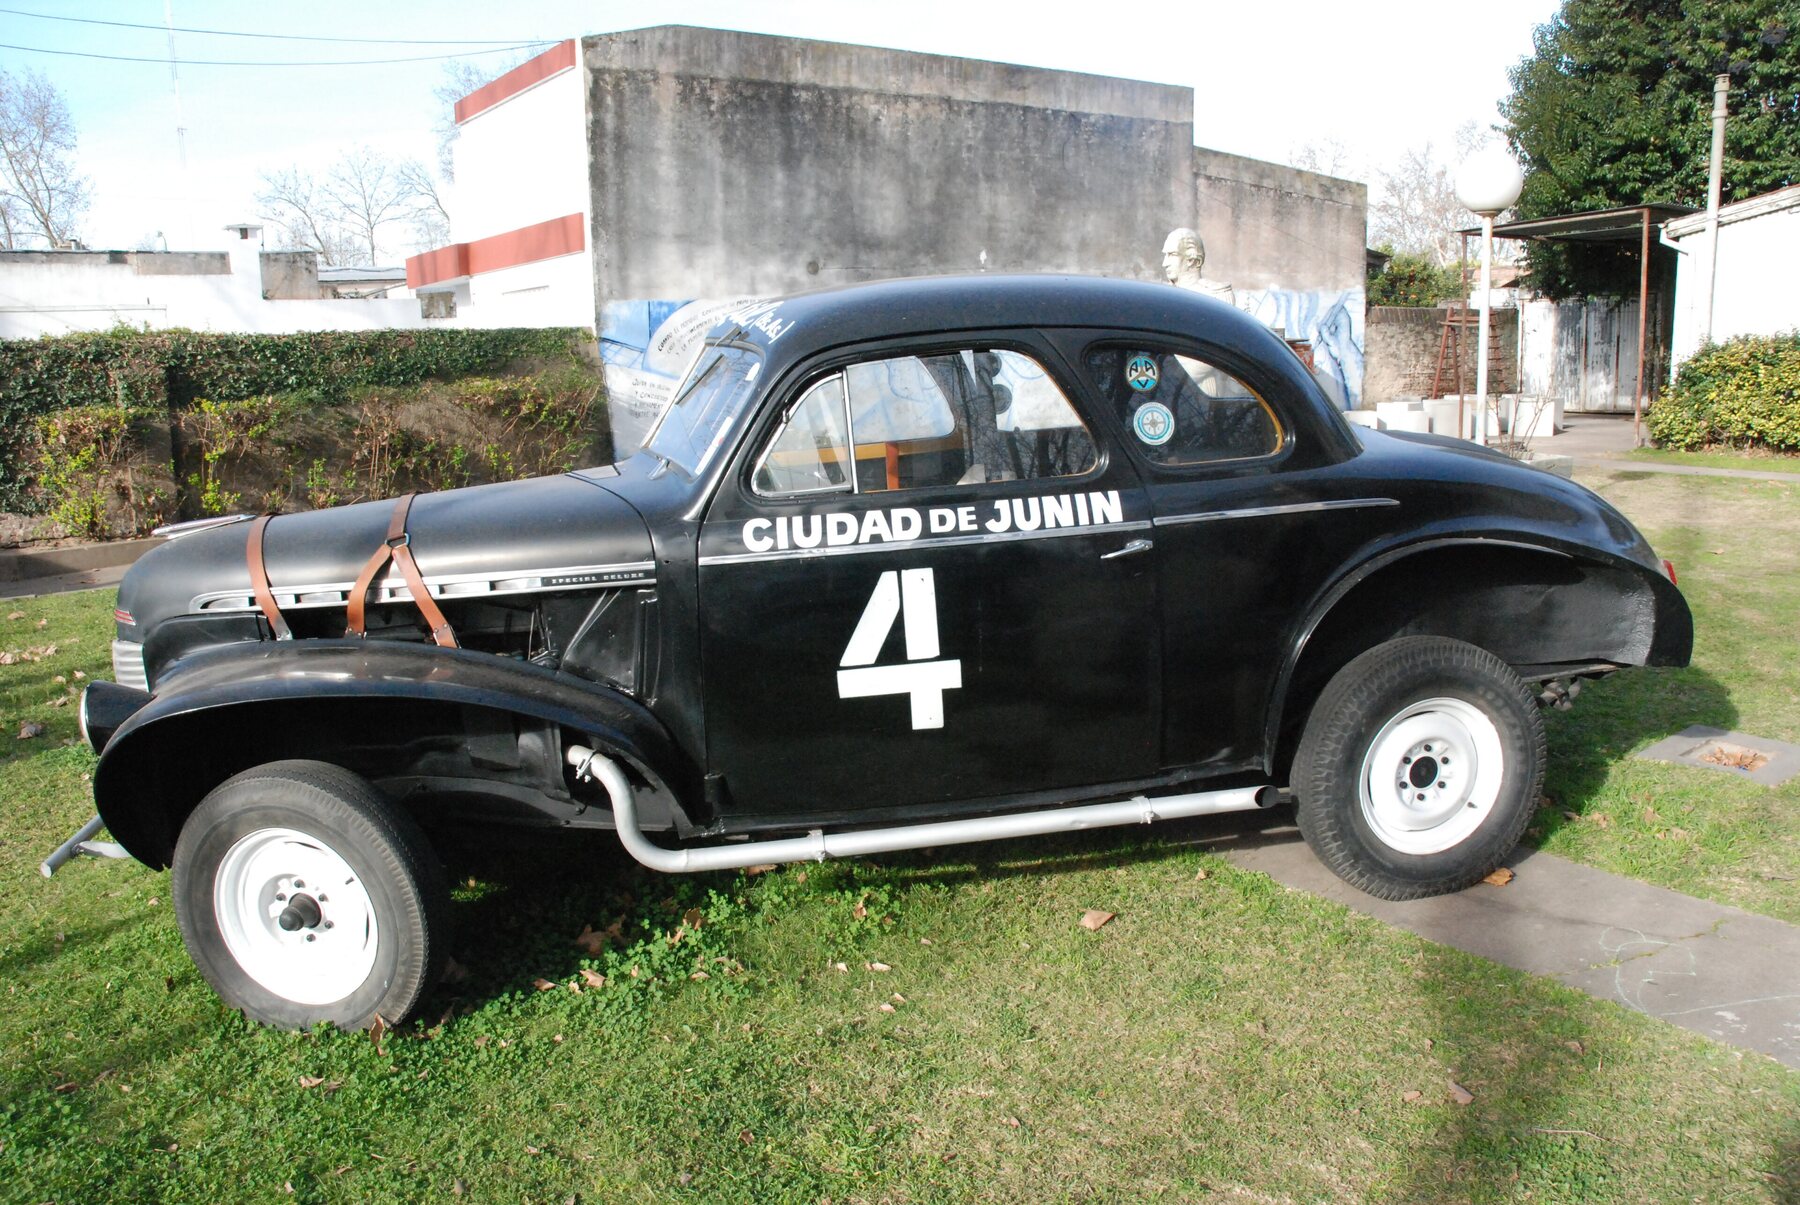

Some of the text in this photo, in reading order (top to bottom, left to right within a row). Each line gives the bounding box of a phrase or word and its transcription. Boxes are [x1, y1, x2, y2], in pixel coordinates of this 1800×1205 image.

[742, 490, 1124, 552] CIUDAD DE JUNIN
[551, 572, 645, 584] SPECIAL DELUXE
[837, 567, 963, 731] 4
